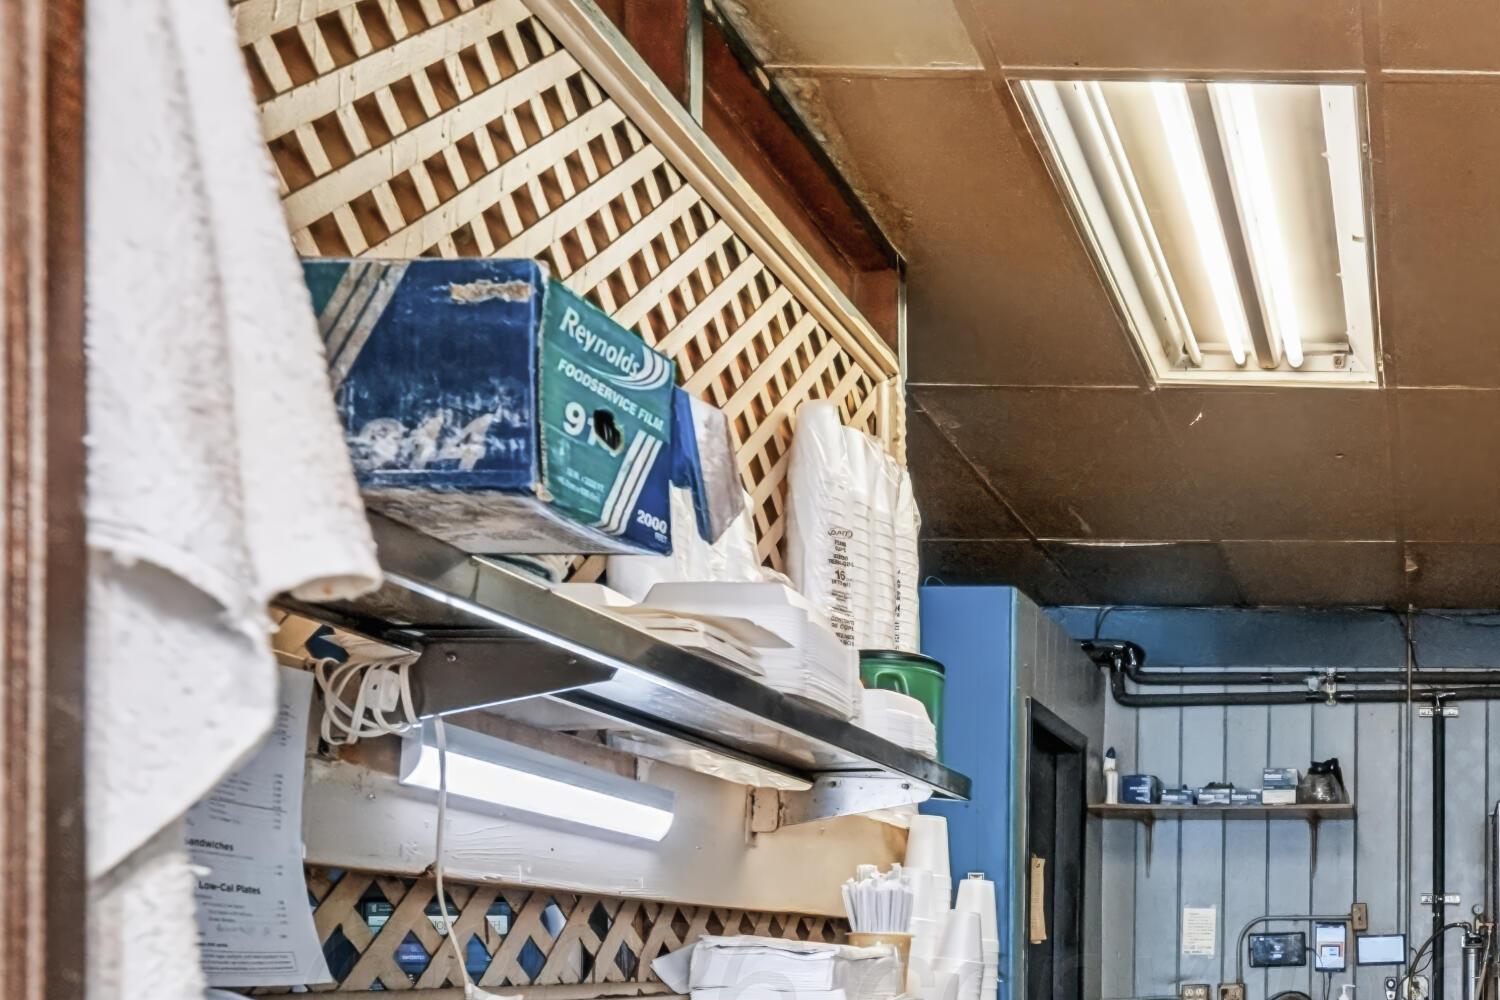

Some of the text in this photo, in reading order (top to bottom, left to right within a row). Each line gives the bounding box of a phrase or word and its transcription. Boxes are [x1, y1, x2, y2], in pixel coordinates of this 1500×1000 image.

[559, 306, 641, 378] Reynolds
[558, 358, 665, 431] FOODSERVICE FILM
[636, 508, 668, 535] 2000
[198, 880, 262, 896] Low-Cal Plates
